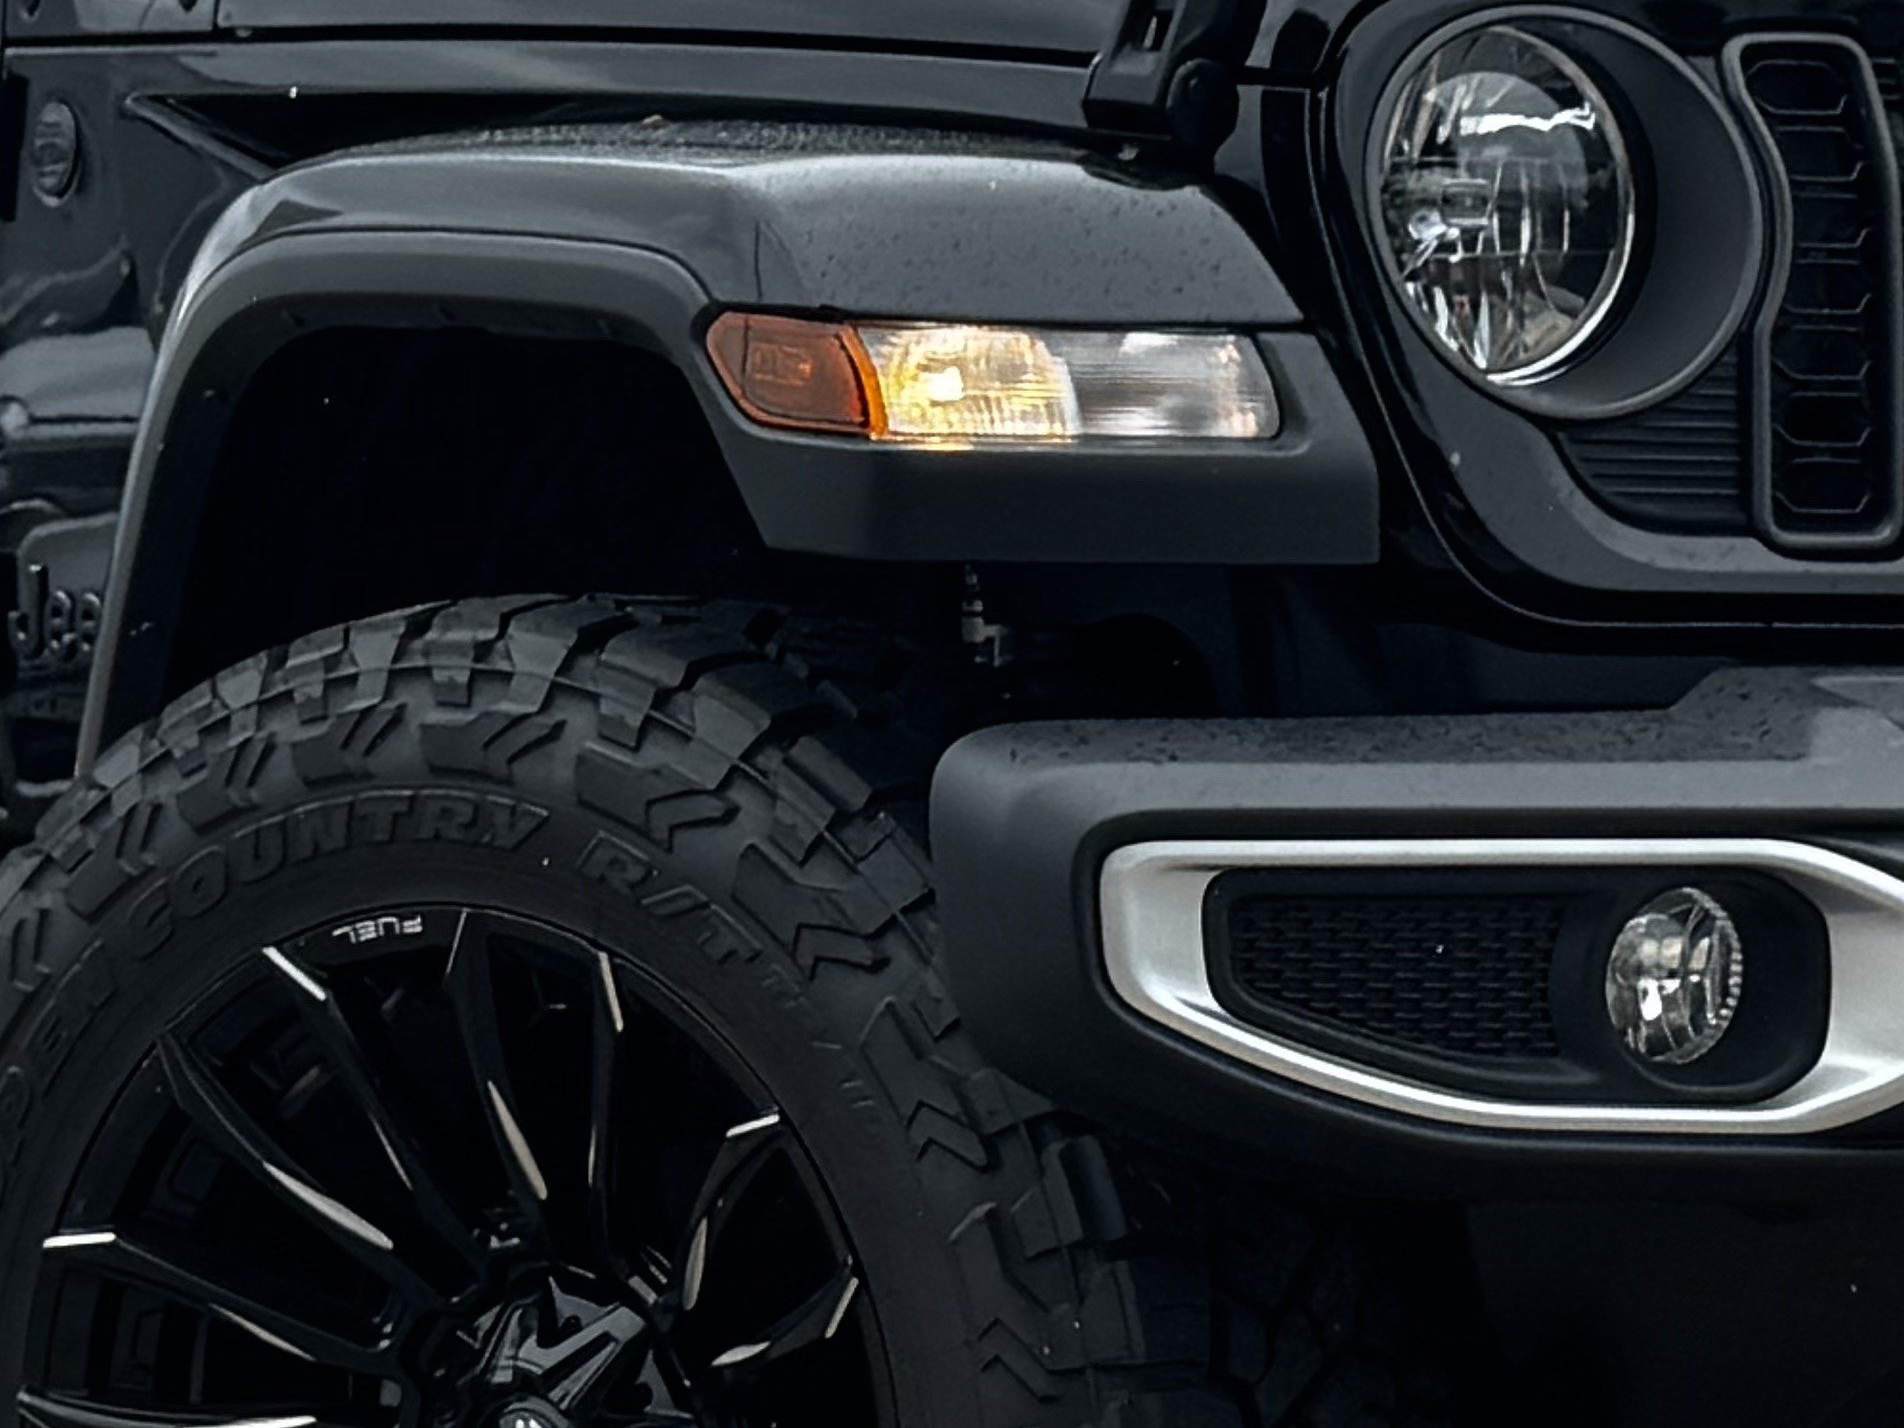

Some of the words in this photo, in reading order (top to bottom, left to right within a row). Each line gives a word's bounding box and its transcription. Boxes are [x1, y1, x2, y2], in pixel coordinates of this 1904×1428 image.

[7, 563, 100, 663] Jee
[128, 787, 550, 962] COUNTRY
[331, 914, 423, 945] FUEL
